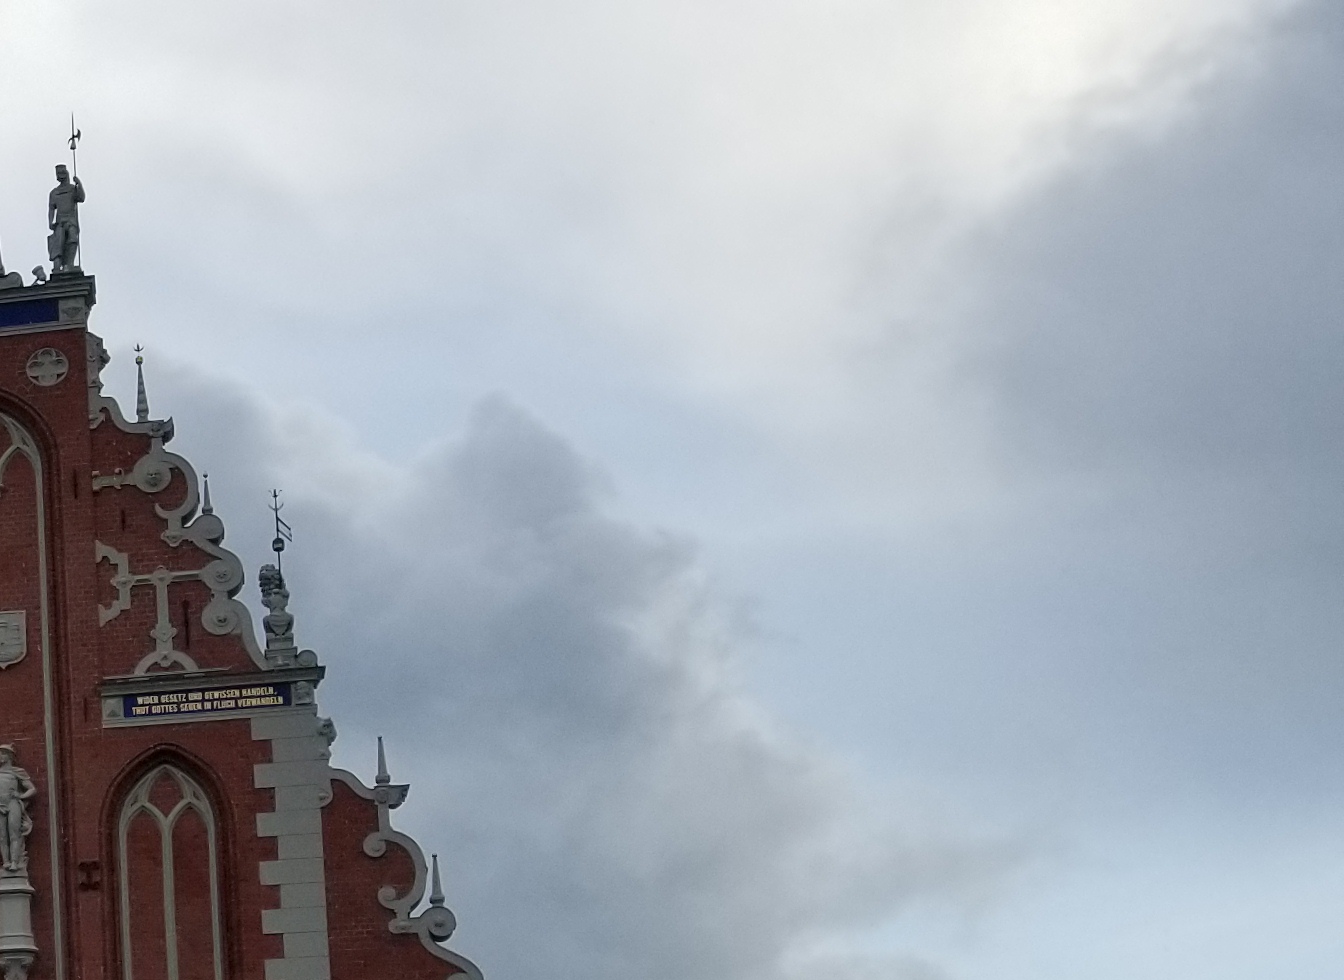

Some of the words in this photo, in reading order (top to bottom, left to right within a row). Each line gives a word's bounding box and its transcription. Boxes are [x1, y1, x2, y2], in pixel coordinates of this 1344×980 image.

[137, 696, 159, 705] WIDER
[160, 694, 186, 703] GESETZ
[204, 689, 240, 700] GEWISSEN
[152, 704, 178, 714] GOTTES
[214, 700, 236, 709] FLUCH
[238, 696, 284, 708] VERWANDELN
